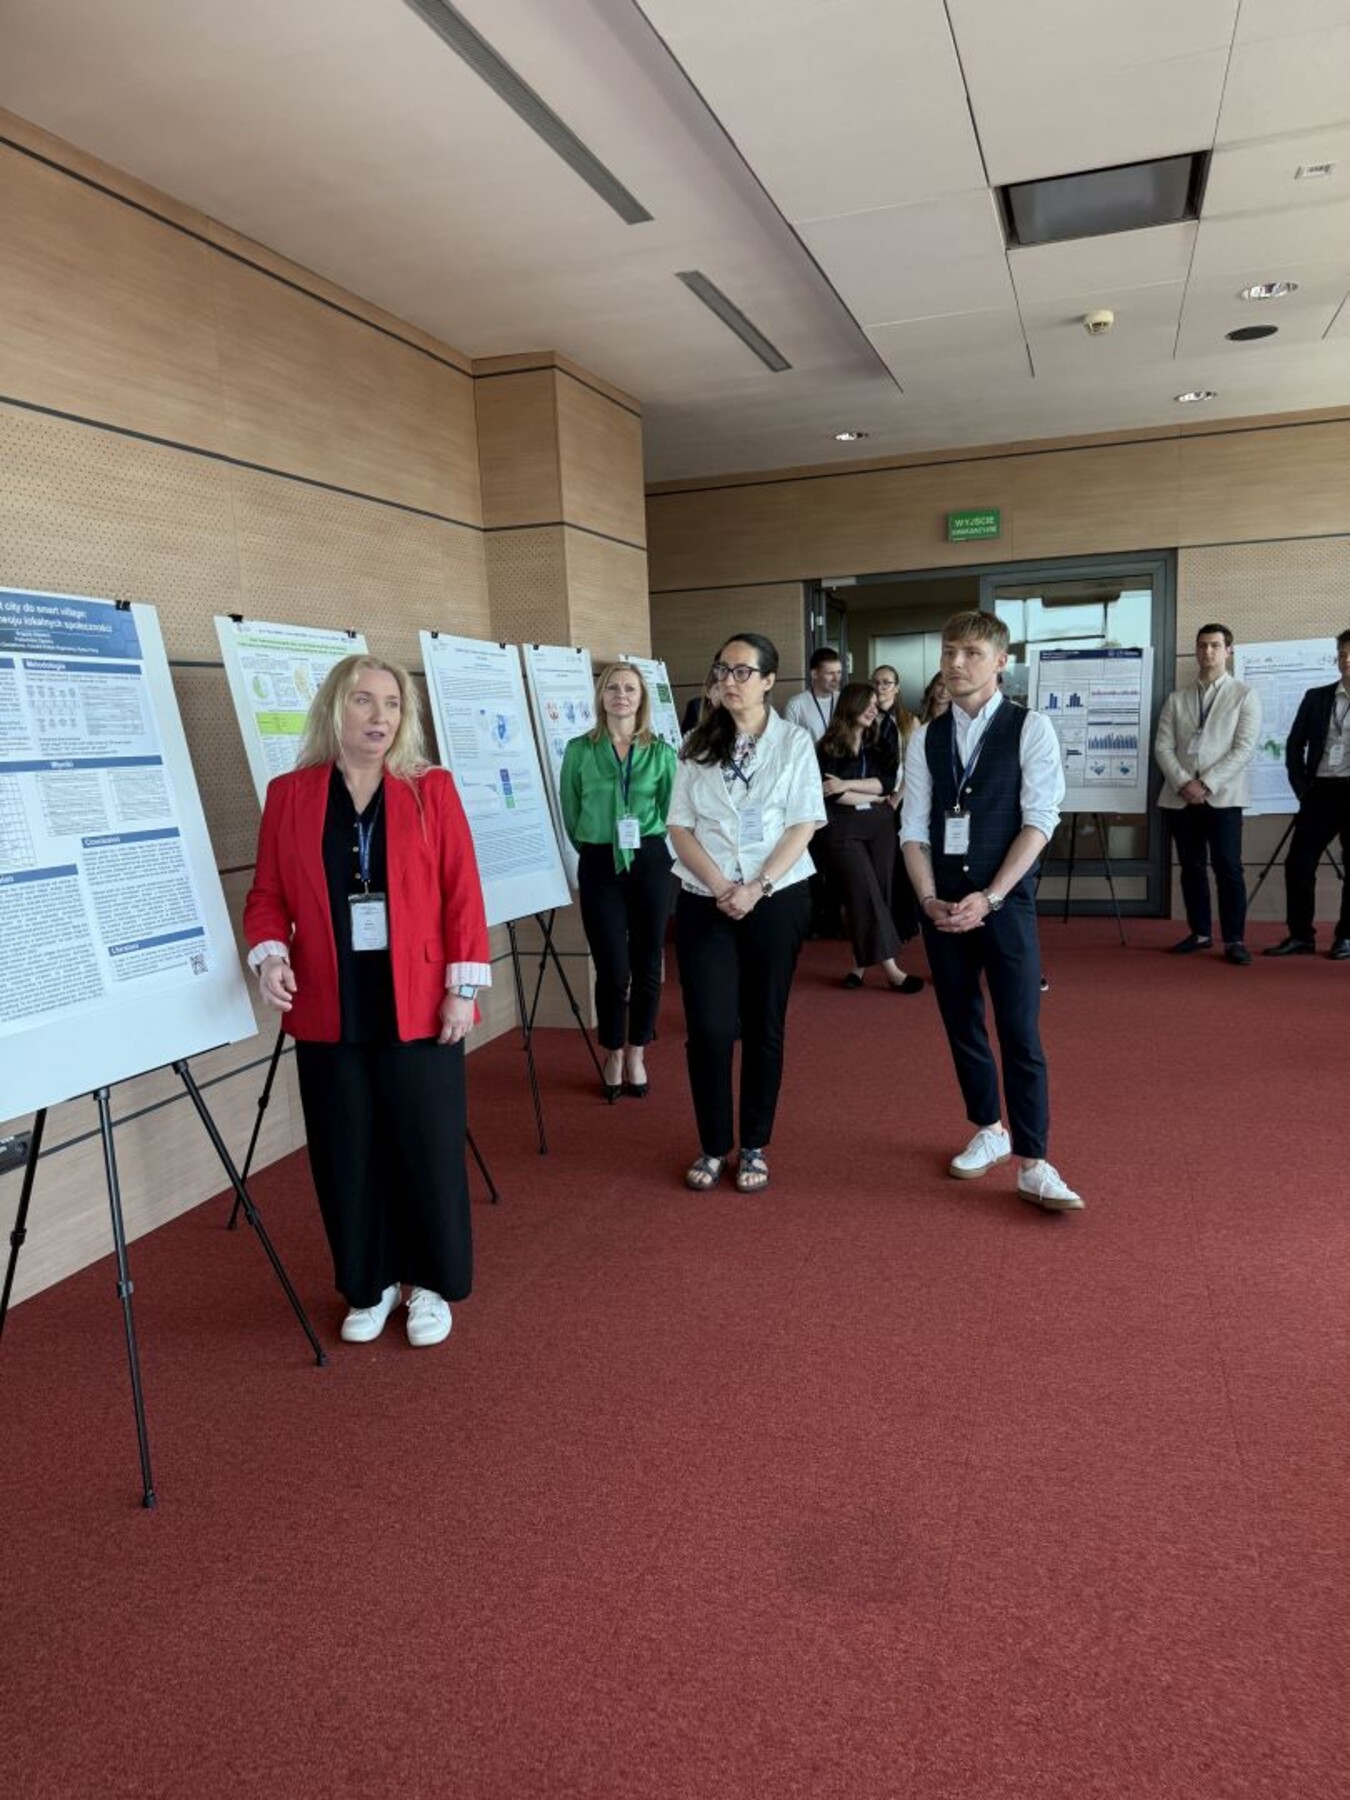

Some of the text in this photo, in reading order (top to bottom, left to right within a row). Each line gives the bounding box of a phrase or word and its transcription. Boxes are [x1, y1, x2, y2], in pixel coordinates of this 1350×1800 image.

[5, 602, 20, 613] city
[23, 603, 36, 612] do
[37, 606, 60, 615] smart
[23, 616, 63, 629] lokalnych
[26, 661, 66, 671] Metodologia
